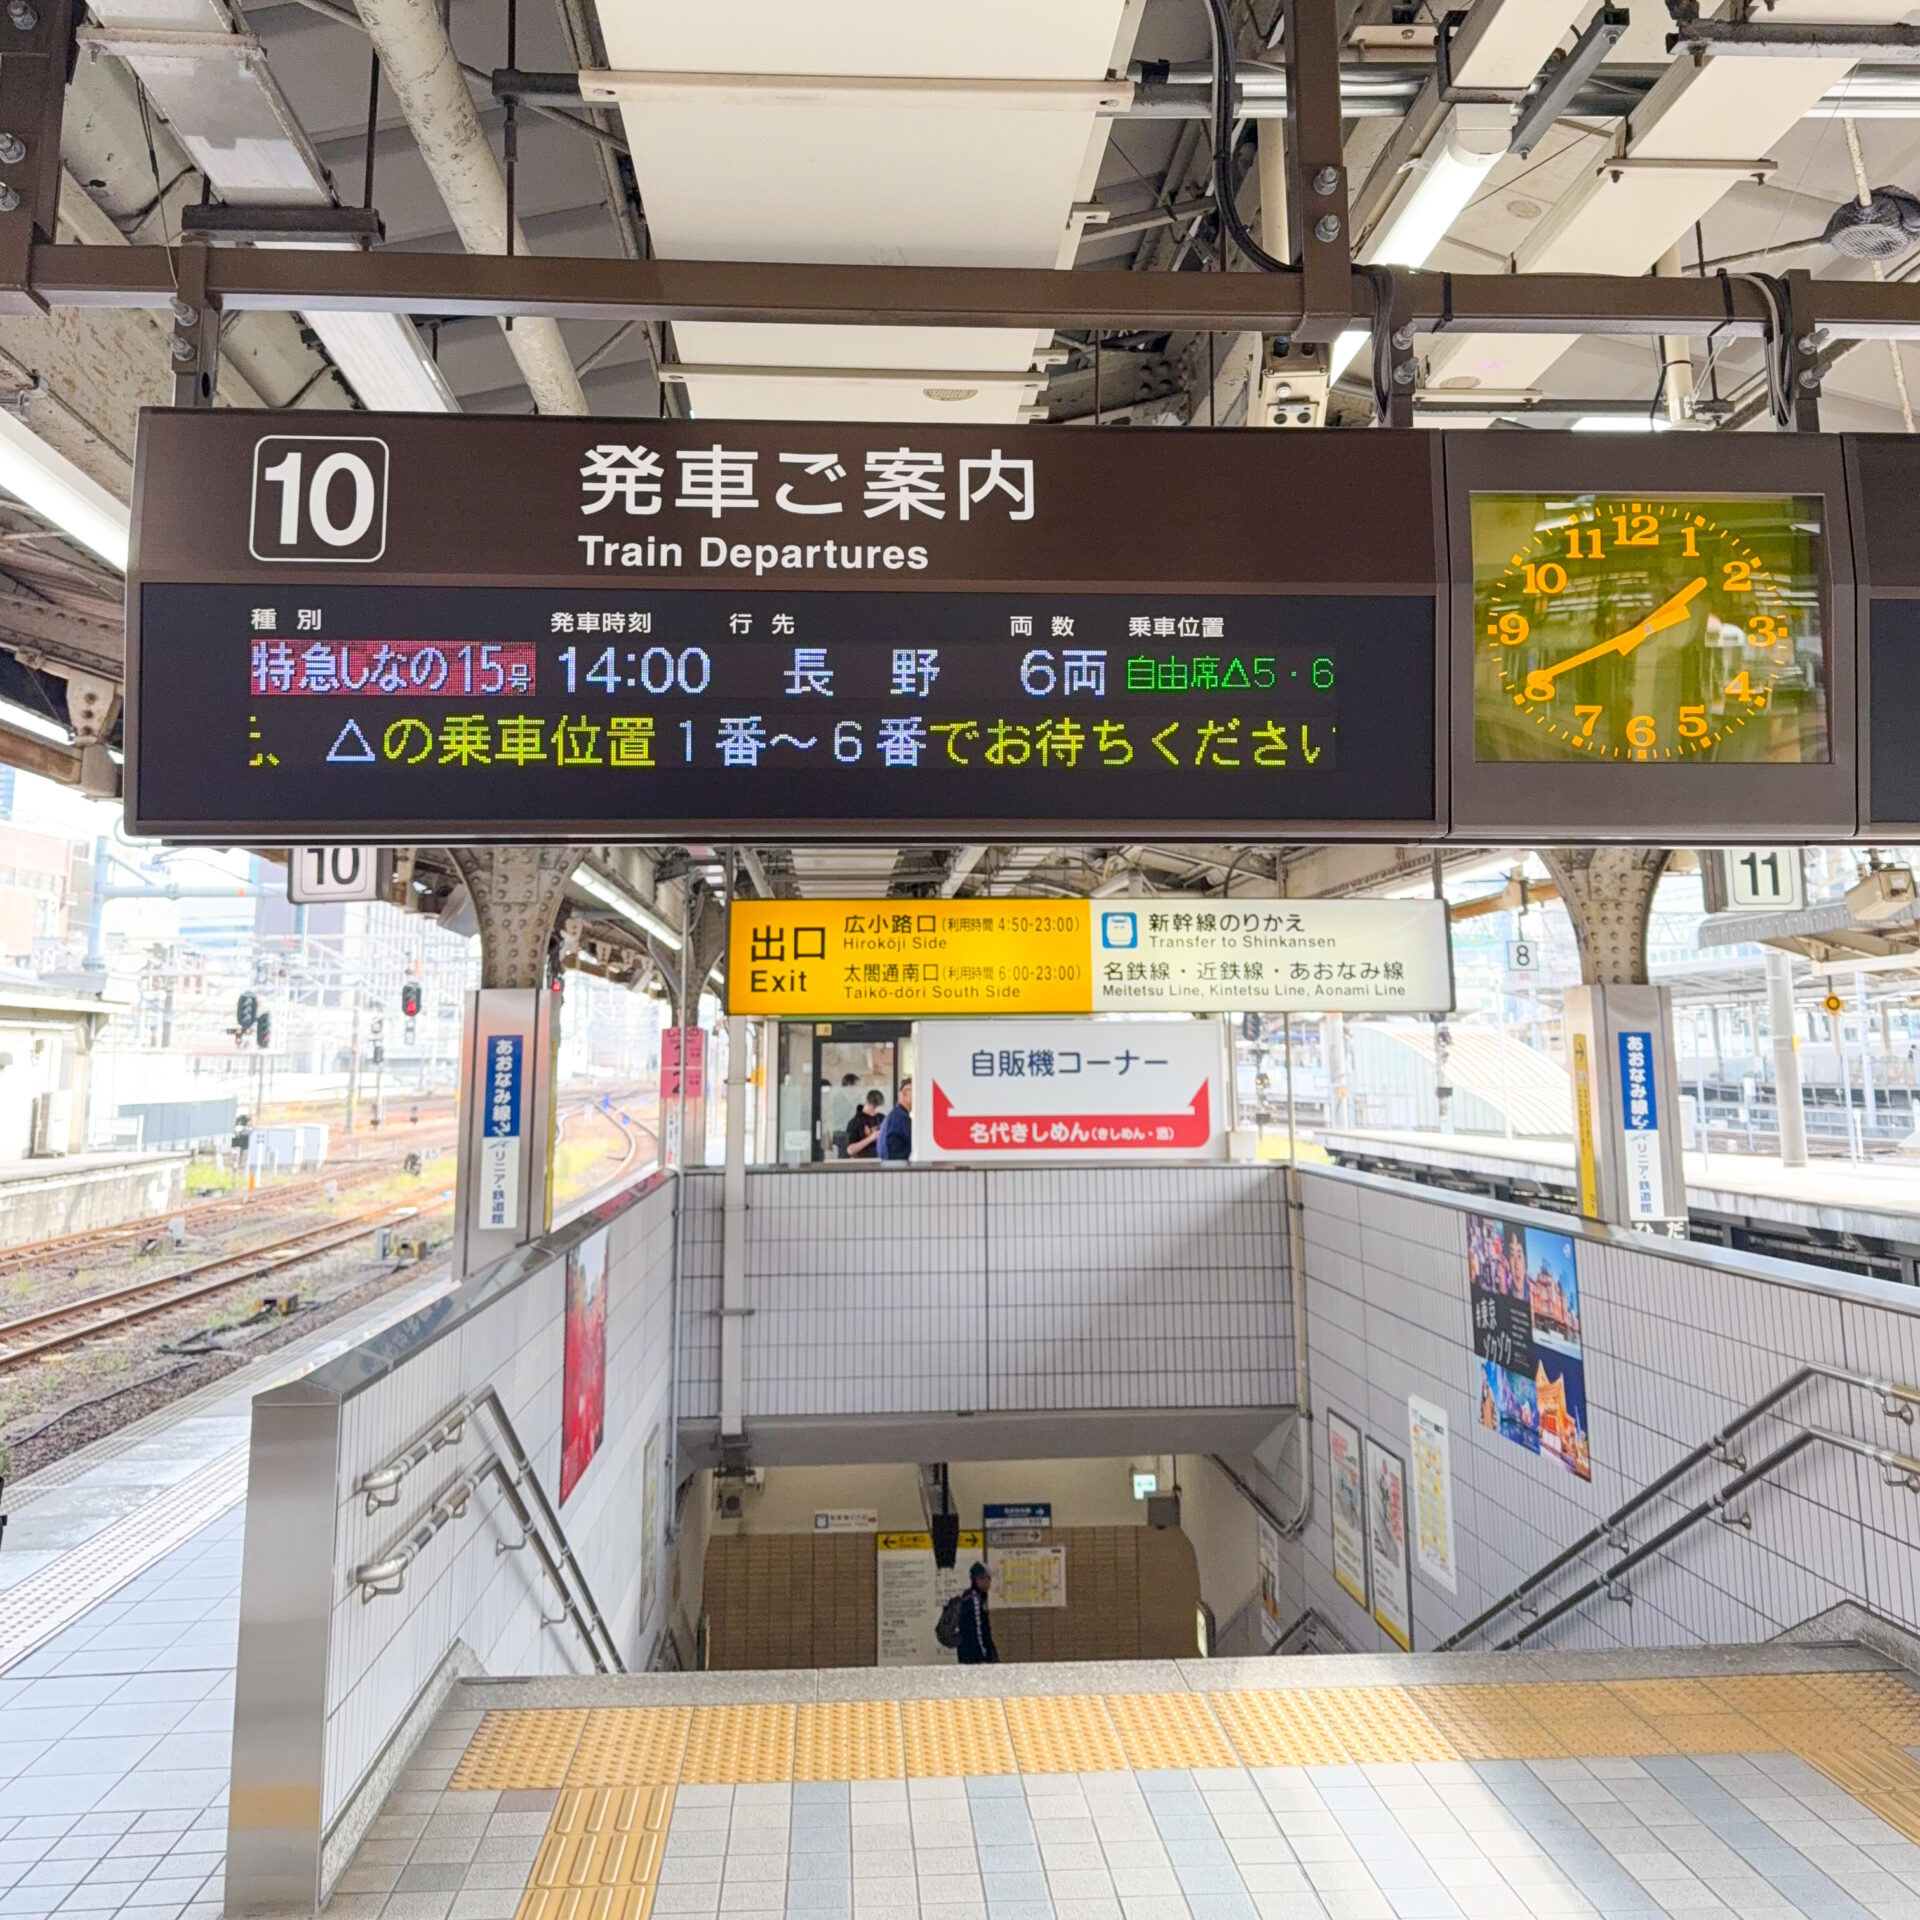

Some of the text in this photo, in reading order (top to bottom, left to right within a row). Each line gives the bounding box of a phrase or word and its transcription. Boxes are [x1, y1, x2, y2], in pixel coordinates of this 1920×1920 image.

[579, 443, 1036, 521] 発車ご案内
[264, 452, 375, 547] 10
[1565, 528, 1606, 559] 11
[1613, 515, 1660, 546] 12
[1682, 526, 1701, 557] 1
[578, 535, 929, 576] Train Departures
[1522, 563, 1567, 594] 10
[1723, 561, 1752, 592] 2
[550, 611, 652, 635] 発車時刻
[1128, 615, 1225, 640] 乗車位置
[1499, 613, 1529, 646] 9
[1748, 616, 1777, 647] 3
[557, 645, 712, 694] 14:00
[1020, 649, 1108, 696] 6両
[1524, 670, 1556, 702] 8
[1724, 671, 1756, 702] 4
[1574, 705, 1603, 737] 7
[1625, 715, 1657, 747] 6
[1678, 705, 1708, 737] 5
[308, 847, 360, 886] 10
[1740, 851, 1782, 897] 11
[1148, 913, 1306, 933] 新幹線のりかえ
[750, 925, 827, 963] 出口
[911, 937, 948, 950] Side
[1149, 935, 1337, 948] Transfer to Shinkansen
[1516, 945, 1531, 967] 8
[750, 969, 808, 993] Exit
[932, 985, 979, 998] South
[985, 985, 1021, 998] Side
[1103, 984, 1406, 999] Meitetsu Line, Kintetsu Line, Aonami Line
[971, 1049, 1169, 1078] 自販機コーナー
[1626, 1035, 1649, 1115] あおなみ線
